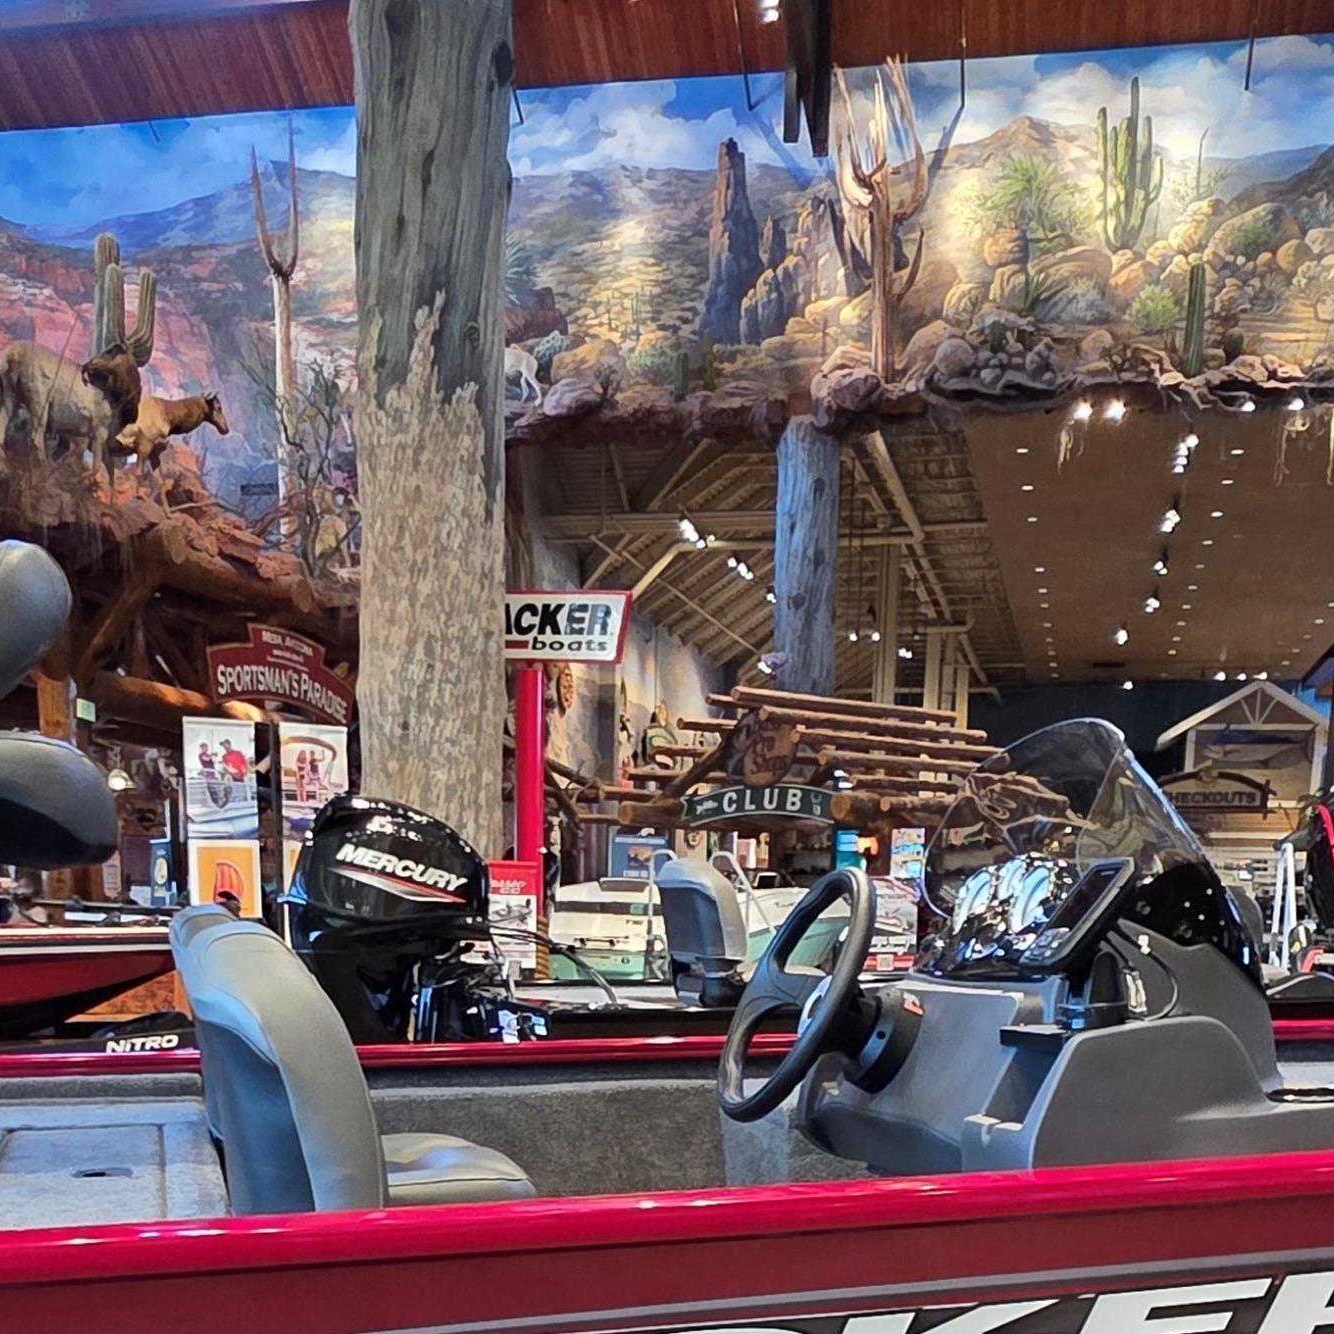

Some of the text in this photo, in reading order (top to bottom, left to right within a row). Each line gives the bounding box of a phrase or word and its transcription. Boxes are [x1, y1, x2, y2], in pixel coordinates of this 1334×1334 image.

[531, 636, 609, 652] boats
[217, 663, 349, 725] SPORTSMAN'S PARADISE
[722, 787, 804, 814] CLUB
[335, 843, 469, 892] MERCURY
[106, 1034, 179, 1054] NITRO
